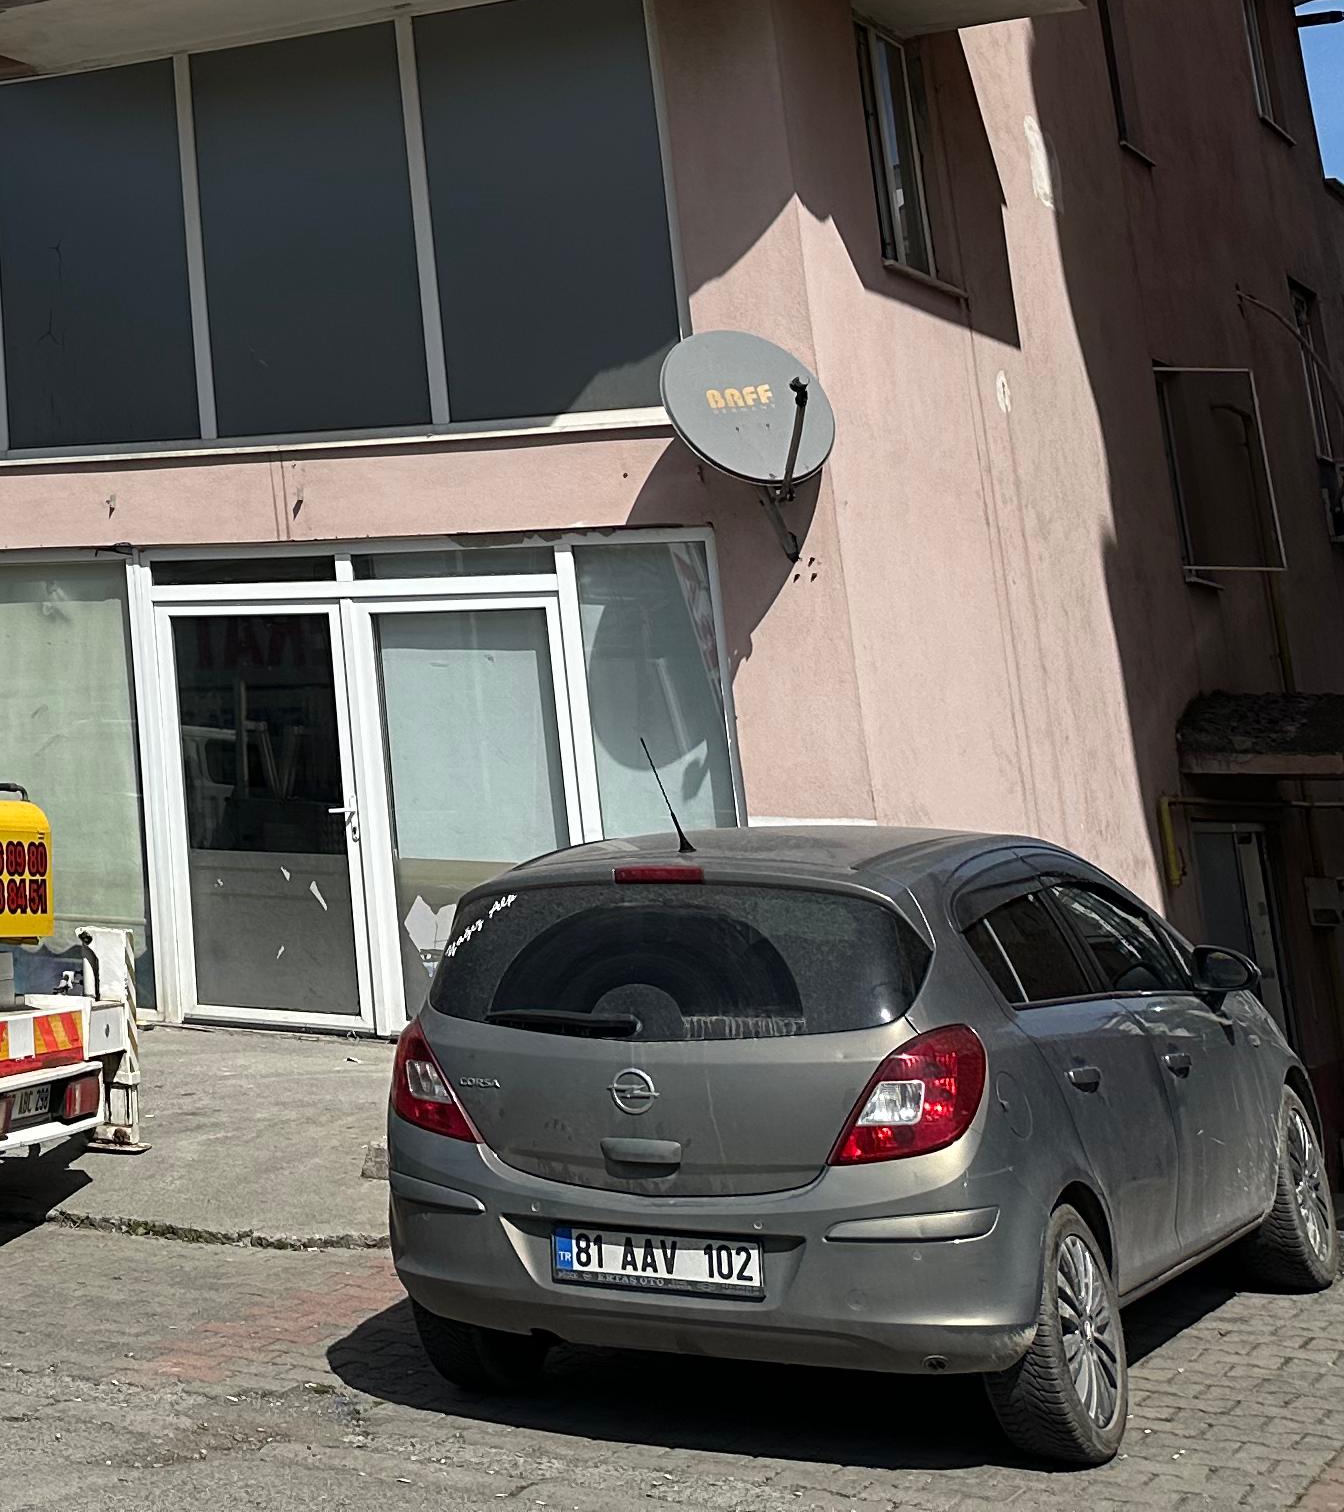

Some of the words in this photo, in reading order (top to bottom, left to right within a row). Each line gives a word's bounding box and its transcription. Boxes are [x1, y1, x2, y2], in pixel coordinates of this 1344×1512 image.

[706, 383, 774, 409] BAFF
[6, 840, 27, 877] 89
[27, 841, 48, 877] 80
[7, 878, 28, 914] 84
[28, 878, 47, 914] 51
[459, 1076, 501, 1088] CORSA
[559, 1251, 572, 1261] TR
[575, 1233, 604, 1268] 81
[621, 1236, 678, 1275] AAV
[703, 1244, 754, 1282] 102
